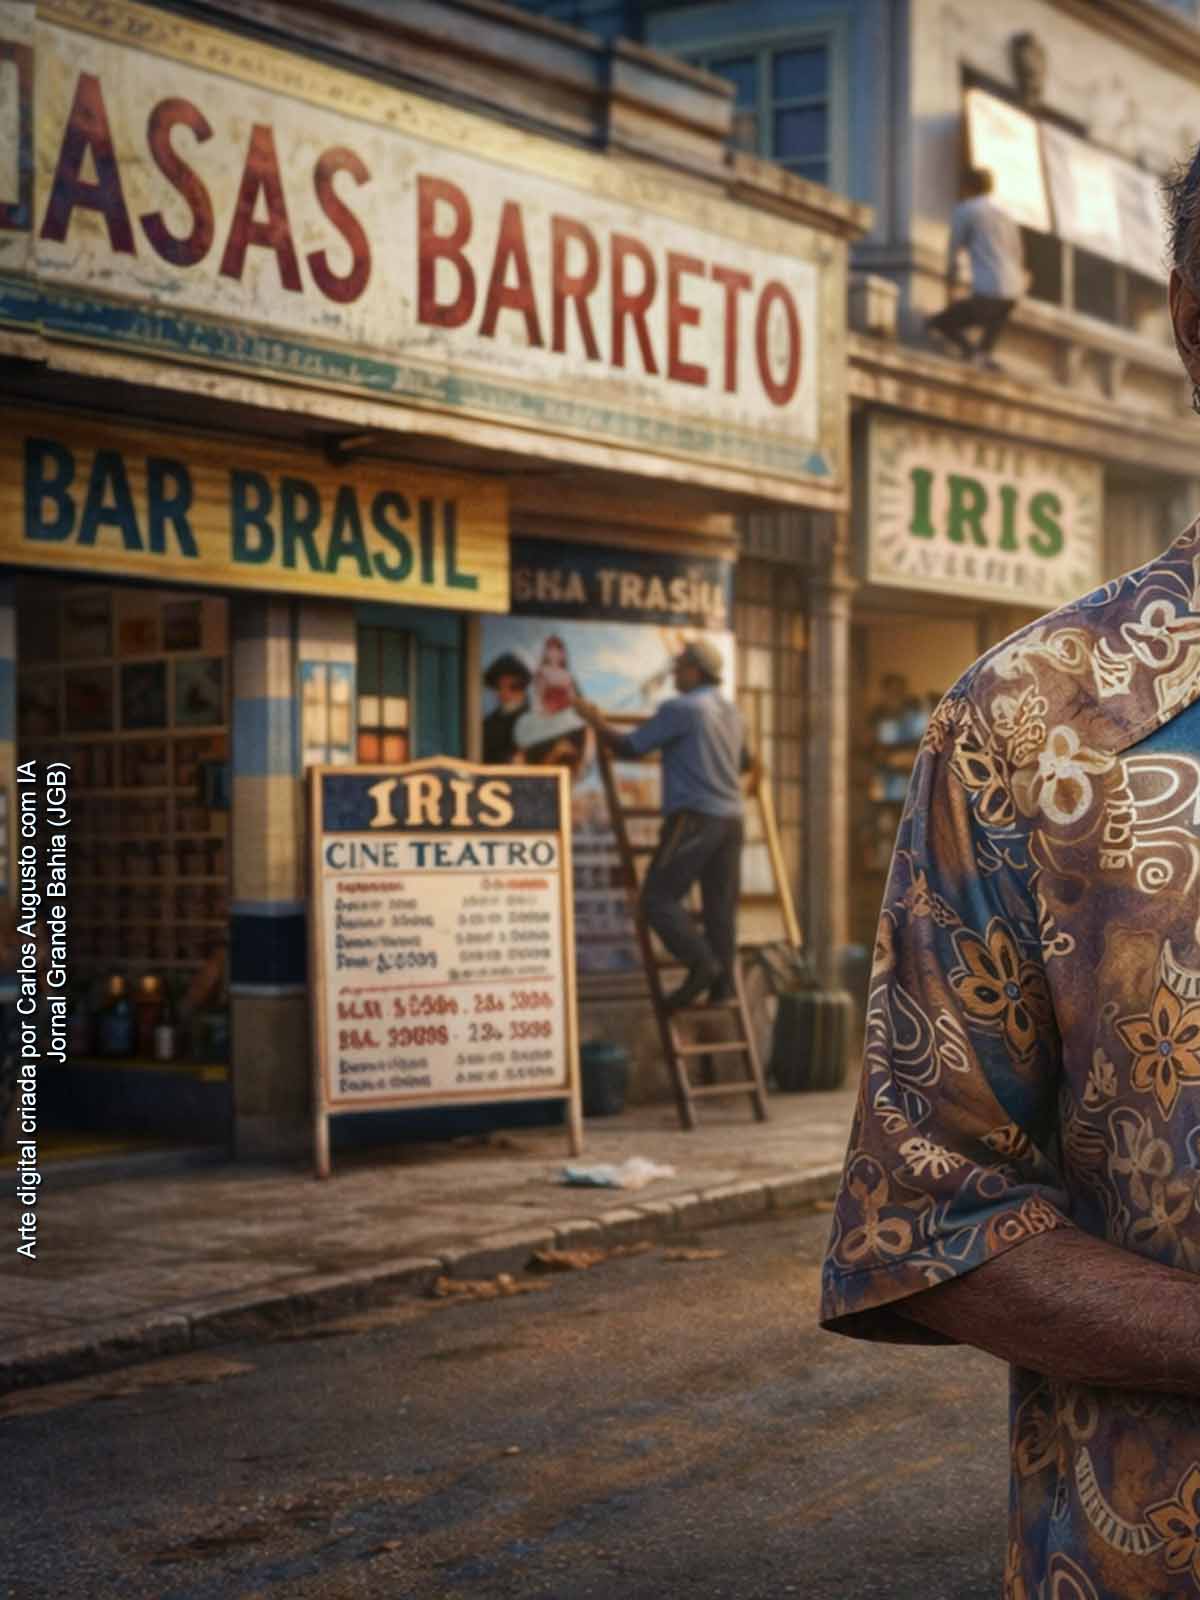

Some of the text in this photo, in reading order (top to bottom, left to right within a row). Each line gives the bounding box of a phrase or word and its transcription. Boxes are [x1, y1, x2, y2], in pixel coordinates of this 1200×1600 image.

[415, 173, 804, 409] BARRETO
[23, 437, 480, 591] BAR BRASIL
[909, 464, 1065, 560] IRIS
[368, 773, 515, 829] IRIS
[325, 840, 556, 870] CINE TEATRO
